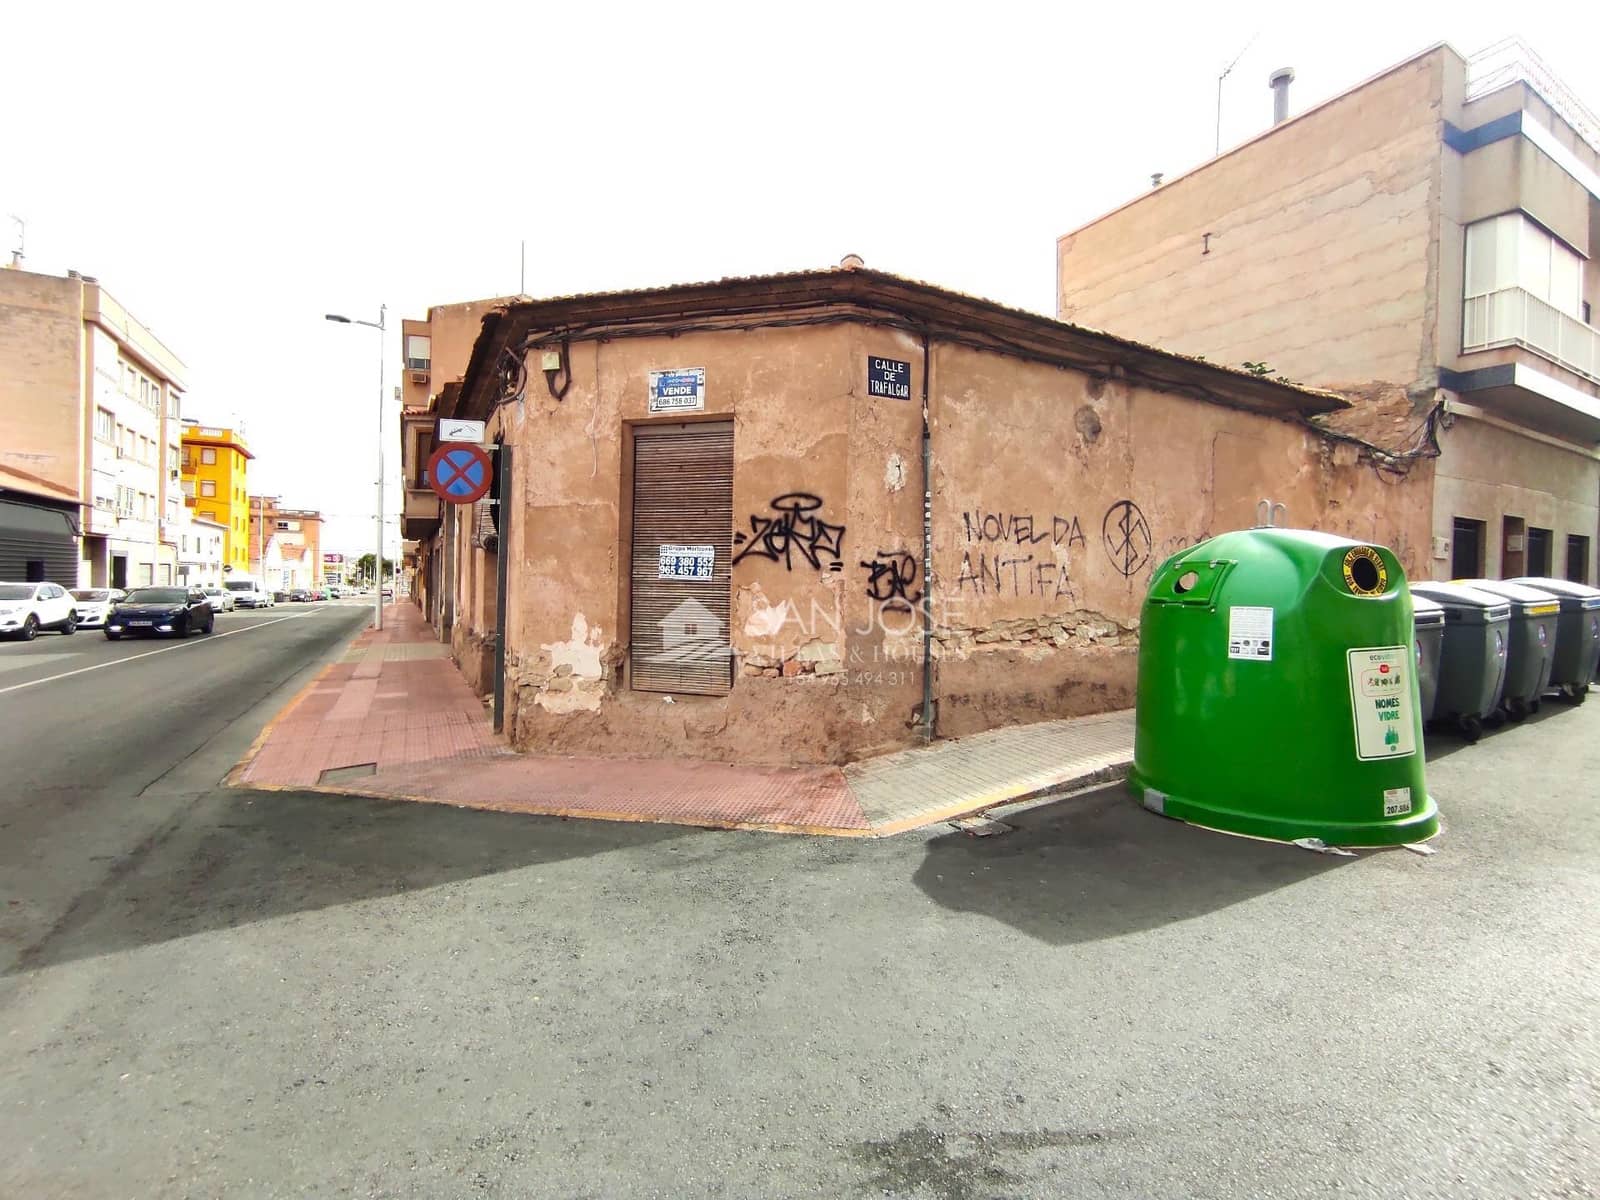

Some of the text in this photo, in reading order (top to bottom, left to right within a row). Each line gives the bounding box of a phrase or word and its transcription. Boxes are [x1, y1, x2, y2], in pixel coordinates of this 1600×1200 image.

[875, 359, 904, 373] CALLE
[884, 371, 896, 382] DE
[663, 386, 692, 395] VENDE
[870, 379, 909, 398] TRAFALGAR
[963, 509, 1086, 548] NOVELDA
[660, 557, 714, 567] 669 380 552
[659, 566, 713, 576] 965 457 967
[958, 551, 1077, 602] ANTIFA
[1378, 709, 1400, 722] VIDRE
